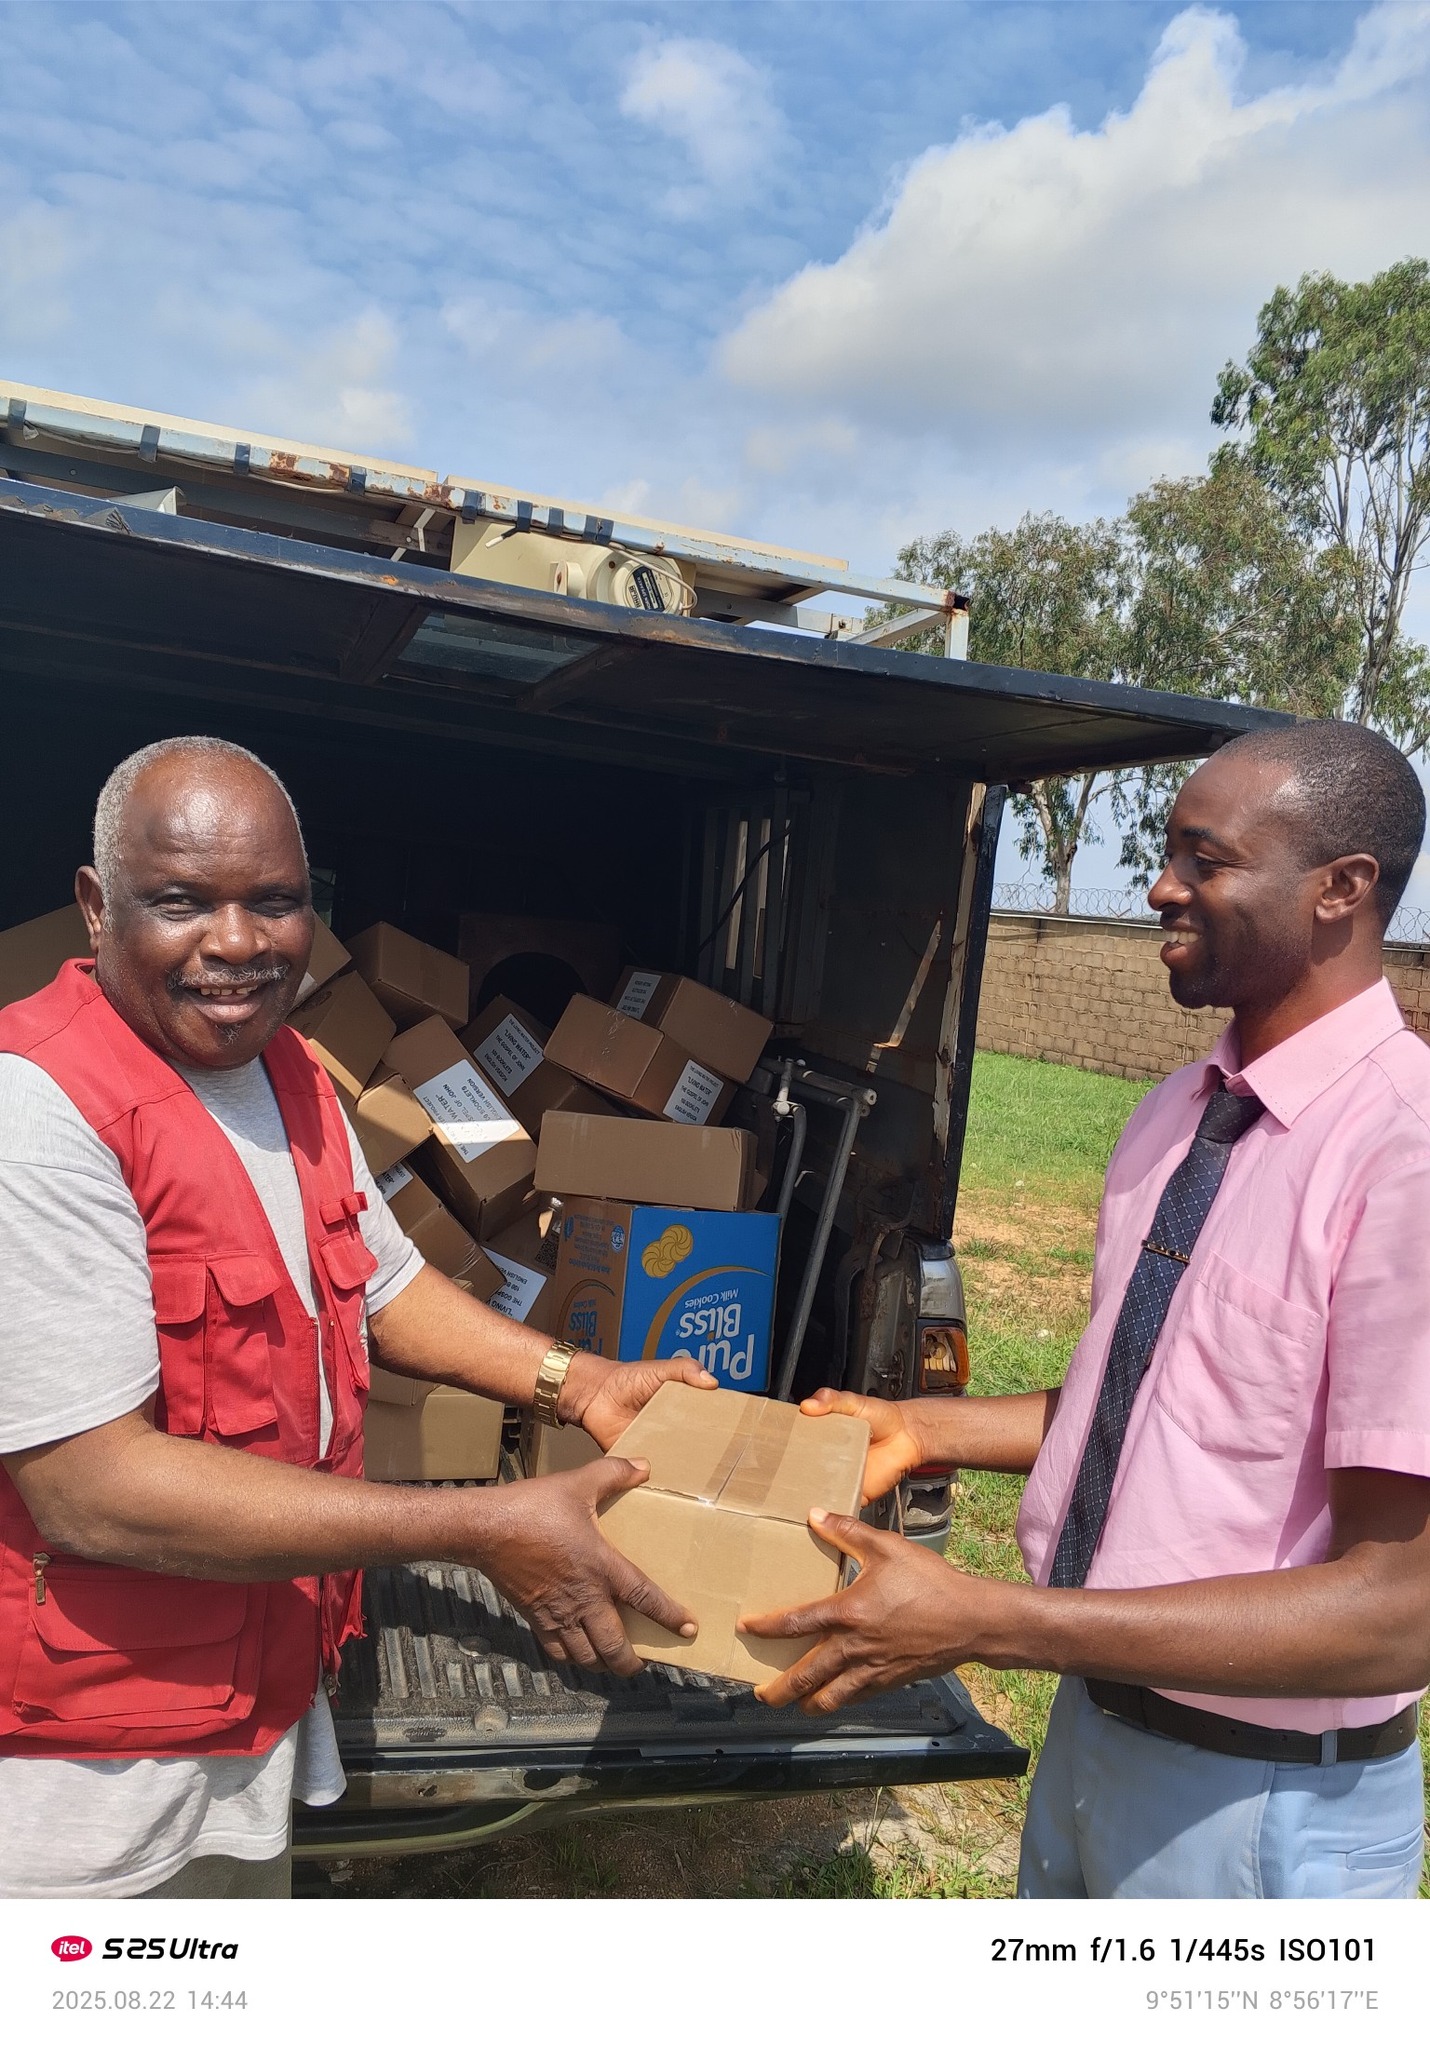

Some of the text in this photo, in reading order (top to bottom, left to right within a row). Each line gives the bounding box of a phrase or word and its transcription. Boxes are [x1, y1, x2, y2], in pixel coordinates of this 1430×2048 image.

[443, 1084, 457, 1098] JOHN
[467, 1078, 485, 1100] VERSION
[423, 1096, 440, 1116] PROJECT
[435, 1095, 458, 1119] WATER"
[454, 1099, 463, 1108] OF
[461, 1085, 485, 1114] BOOKLETS
[506, 1271, 528, 1285] ENGLISH
[512, 1297, 523, 1307] THE
[685, 1288, 739, 1309] Milk Cookies
[491, 1300, 513, 1317] "LIVING
